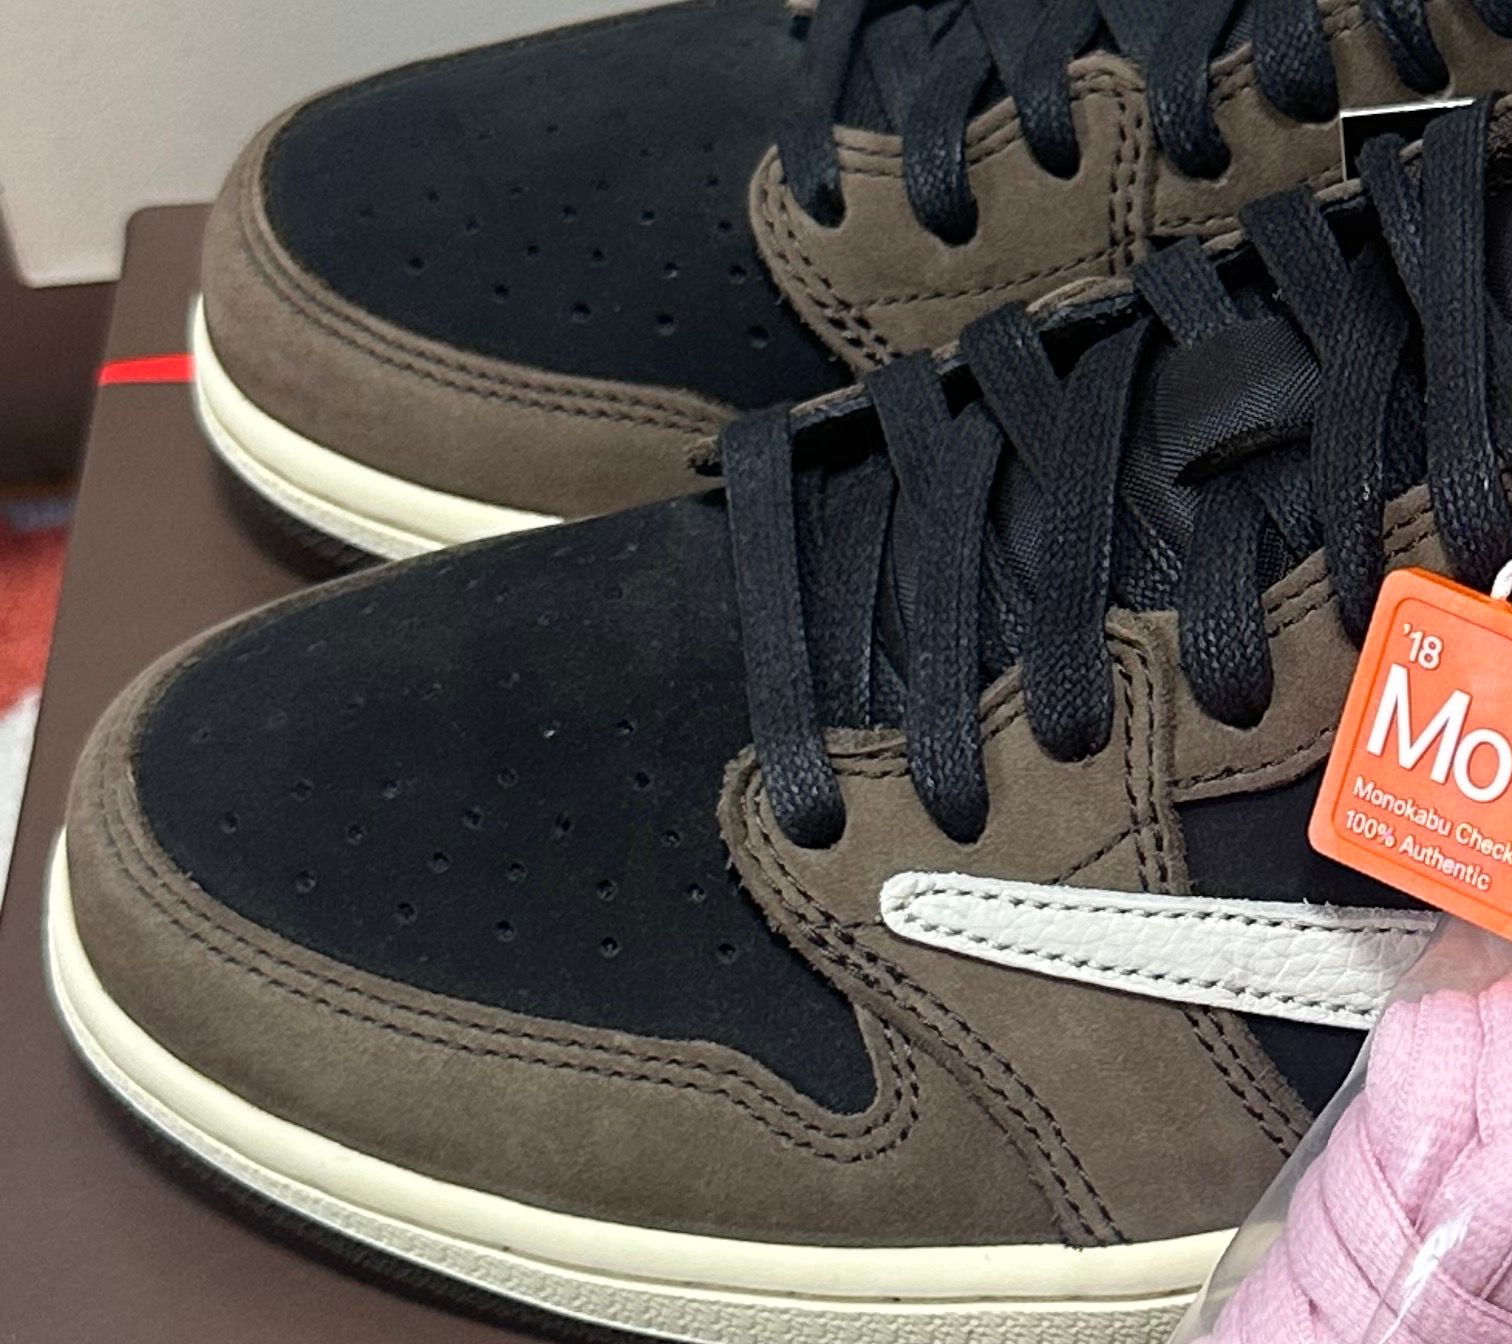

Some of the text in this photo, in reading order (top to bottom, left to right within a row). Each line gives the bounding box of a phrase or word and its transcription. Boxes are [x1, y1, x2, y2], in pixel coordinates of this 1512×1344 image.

[1402, 623, 1445, 671] '18
[1351, 775, 1453, 837] Monokabu
[1344, 809, 1492, 893] 100% Authentic
